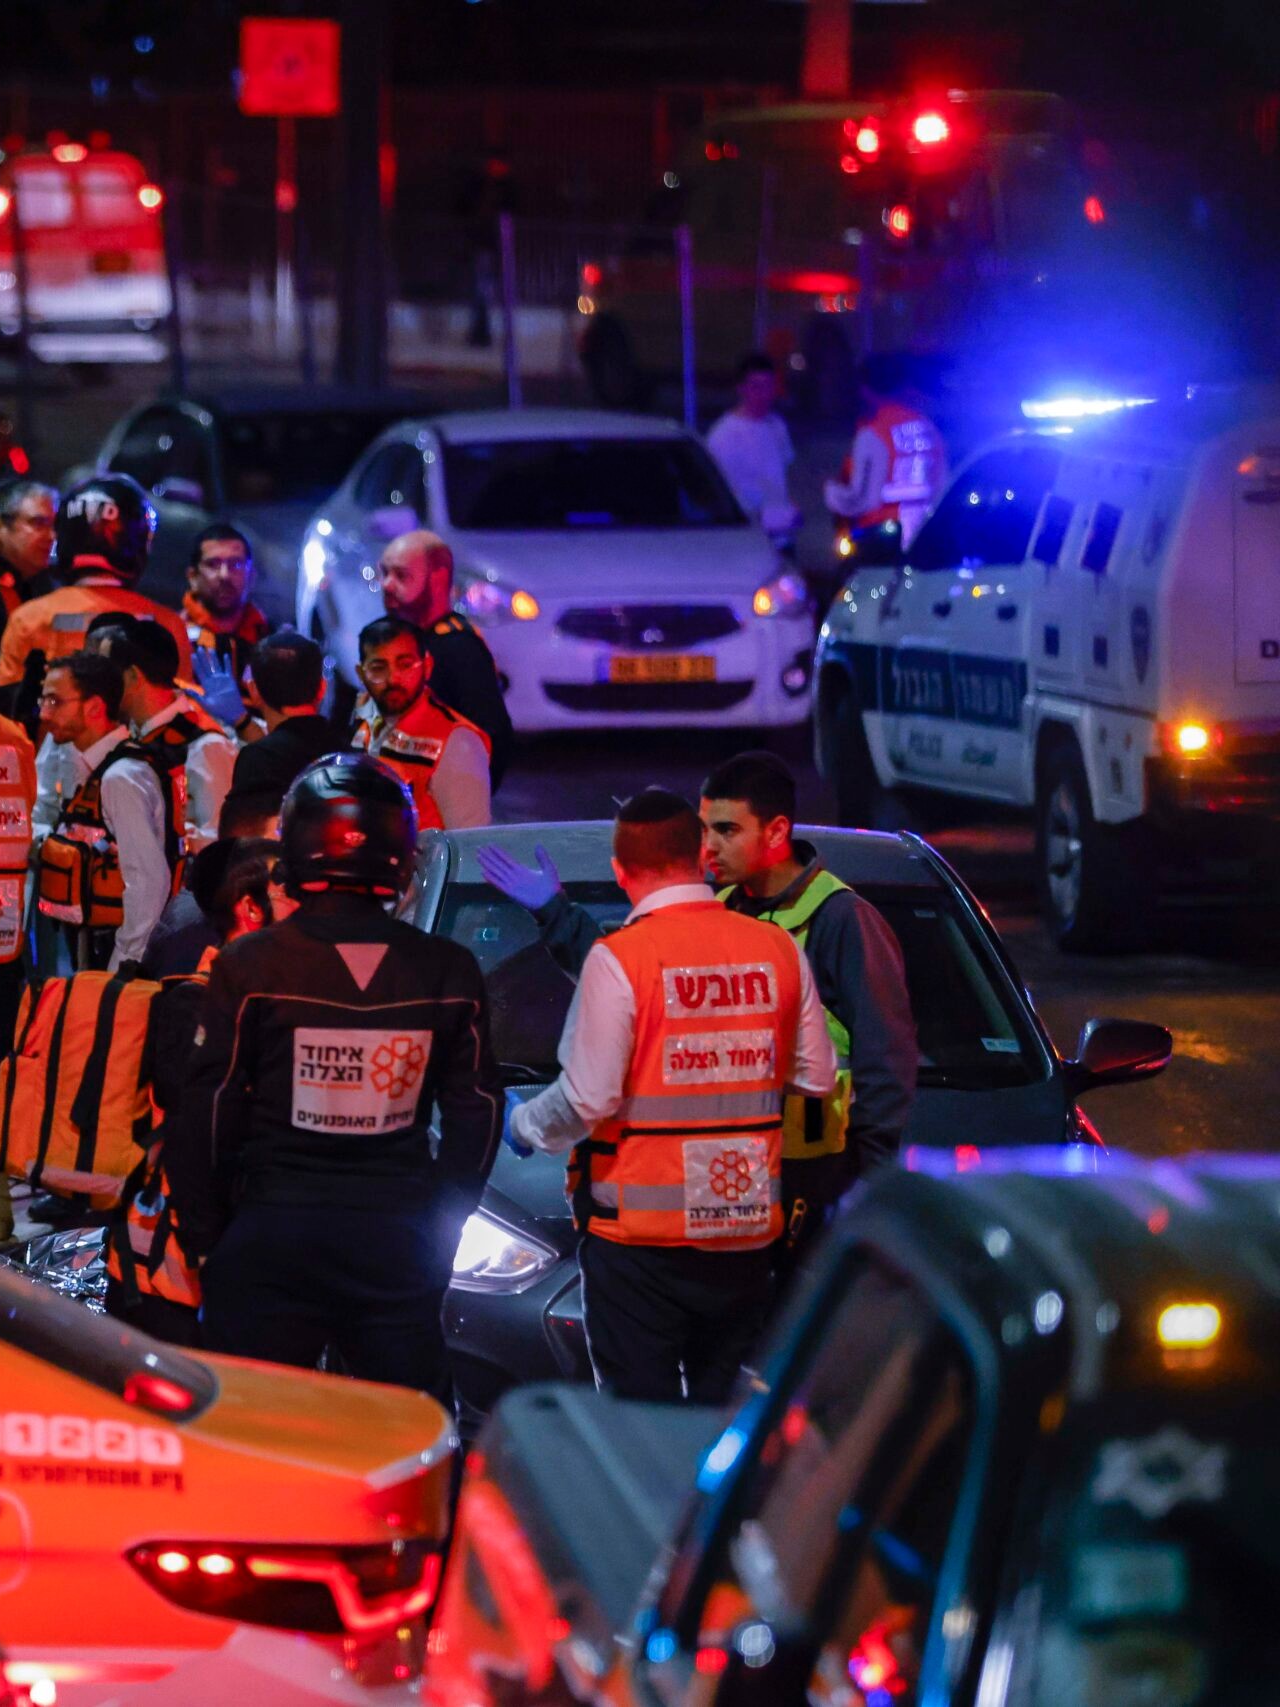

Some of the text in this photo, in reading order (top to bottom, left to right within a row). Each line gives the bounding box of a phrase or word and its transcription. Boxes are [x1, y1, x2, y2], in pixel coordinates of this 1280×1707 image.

[674, 971, 771, 1009] חובש
[299, 1044, 364, 1062] איחוד
[670, 1048, 771, 1071] איחוד הצלה
[300, 1062, 363, 1082] הצלה
[297, 1109, 377, 1129] האופנועים
[689, 1206, 732, 1219] הצלה
[14, 1420, 172, 1457] 1221
